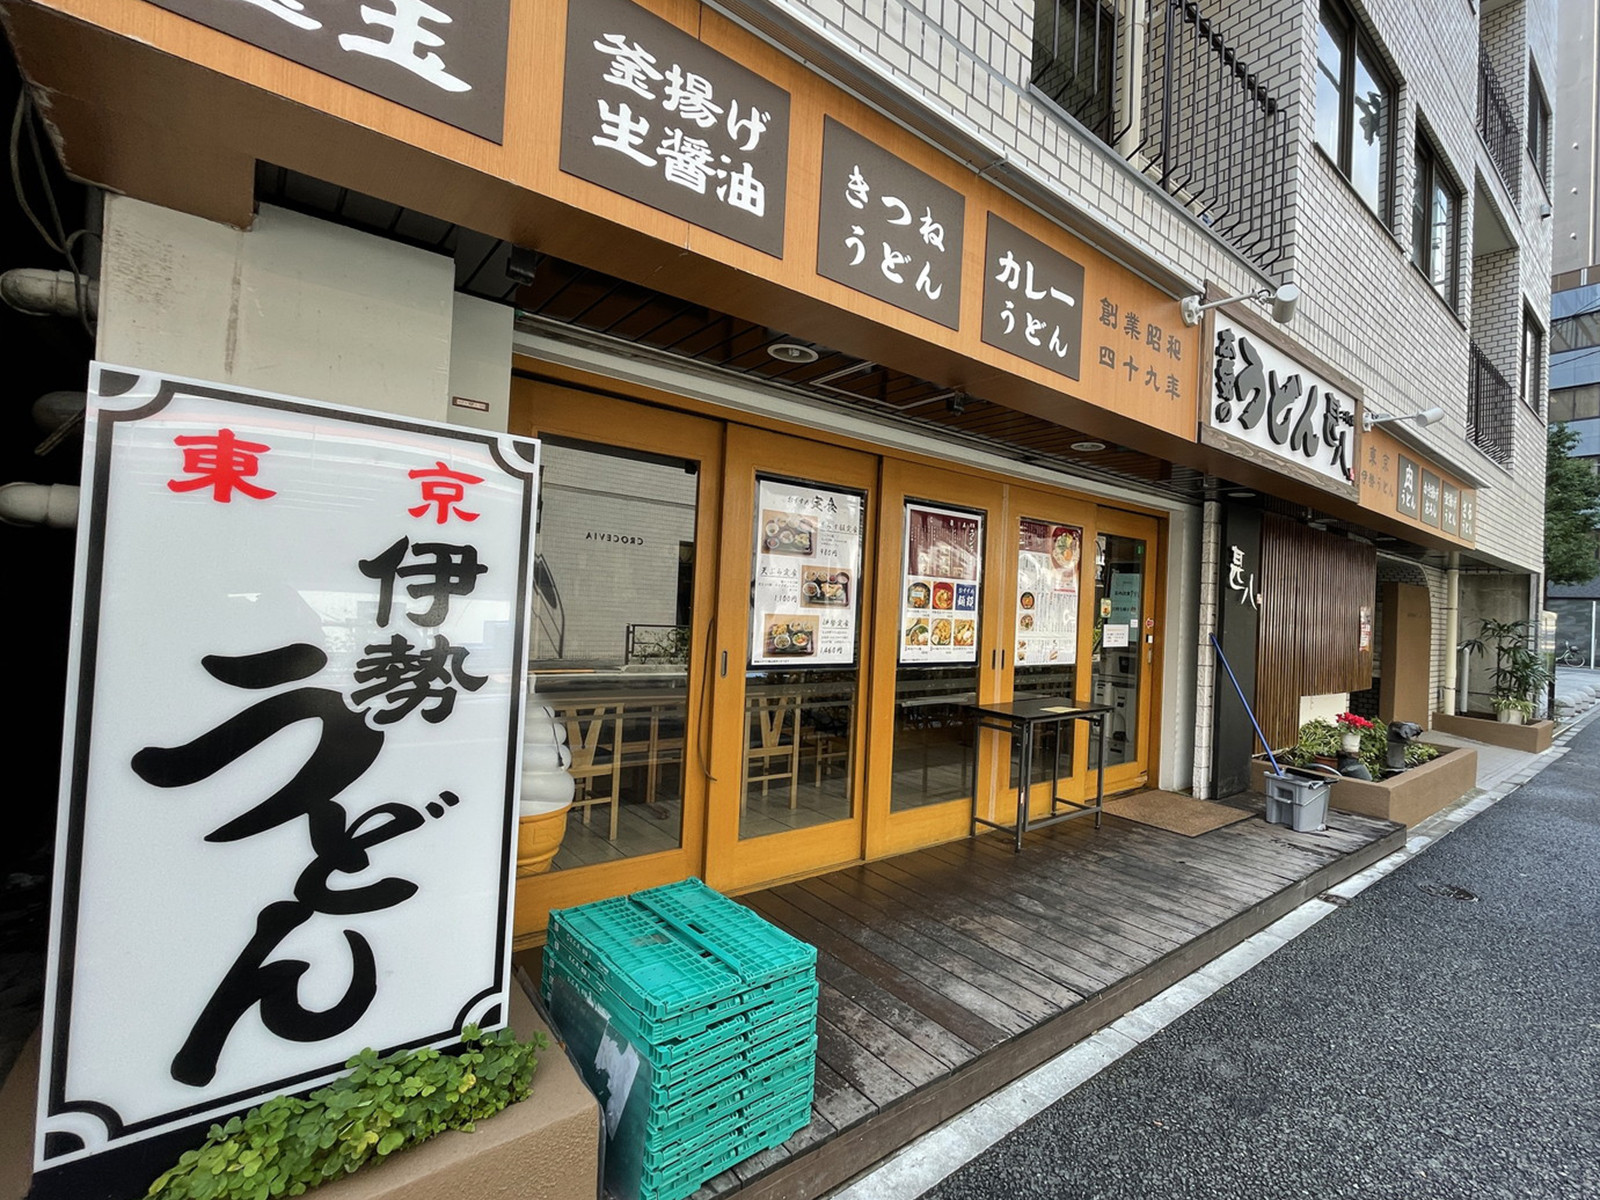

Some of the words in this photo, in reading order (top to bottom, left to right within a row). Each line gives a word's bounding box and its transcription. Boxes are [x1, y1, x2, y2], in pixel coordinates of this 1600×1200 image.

[236, 0, 473, 92] 玉
[593, 34, 771, 150] 釜揚げ
[592, 99, 765, 217] 生醤油
[845, 165, 945, 252] きつね
[845, 225, 943, 300] うどん
[995, 251, 1075, 307] カレー
[1000, 300, 1068, 357] うどん
[1099, 297, 1181, 361] 創業昭和
[1099, 345, 1181, 400] 四十九年
[168, 428, 483, 525] 東京
[349, 534, 489, 725] 伊勢
[131, 643, 459, 1087] うどん
